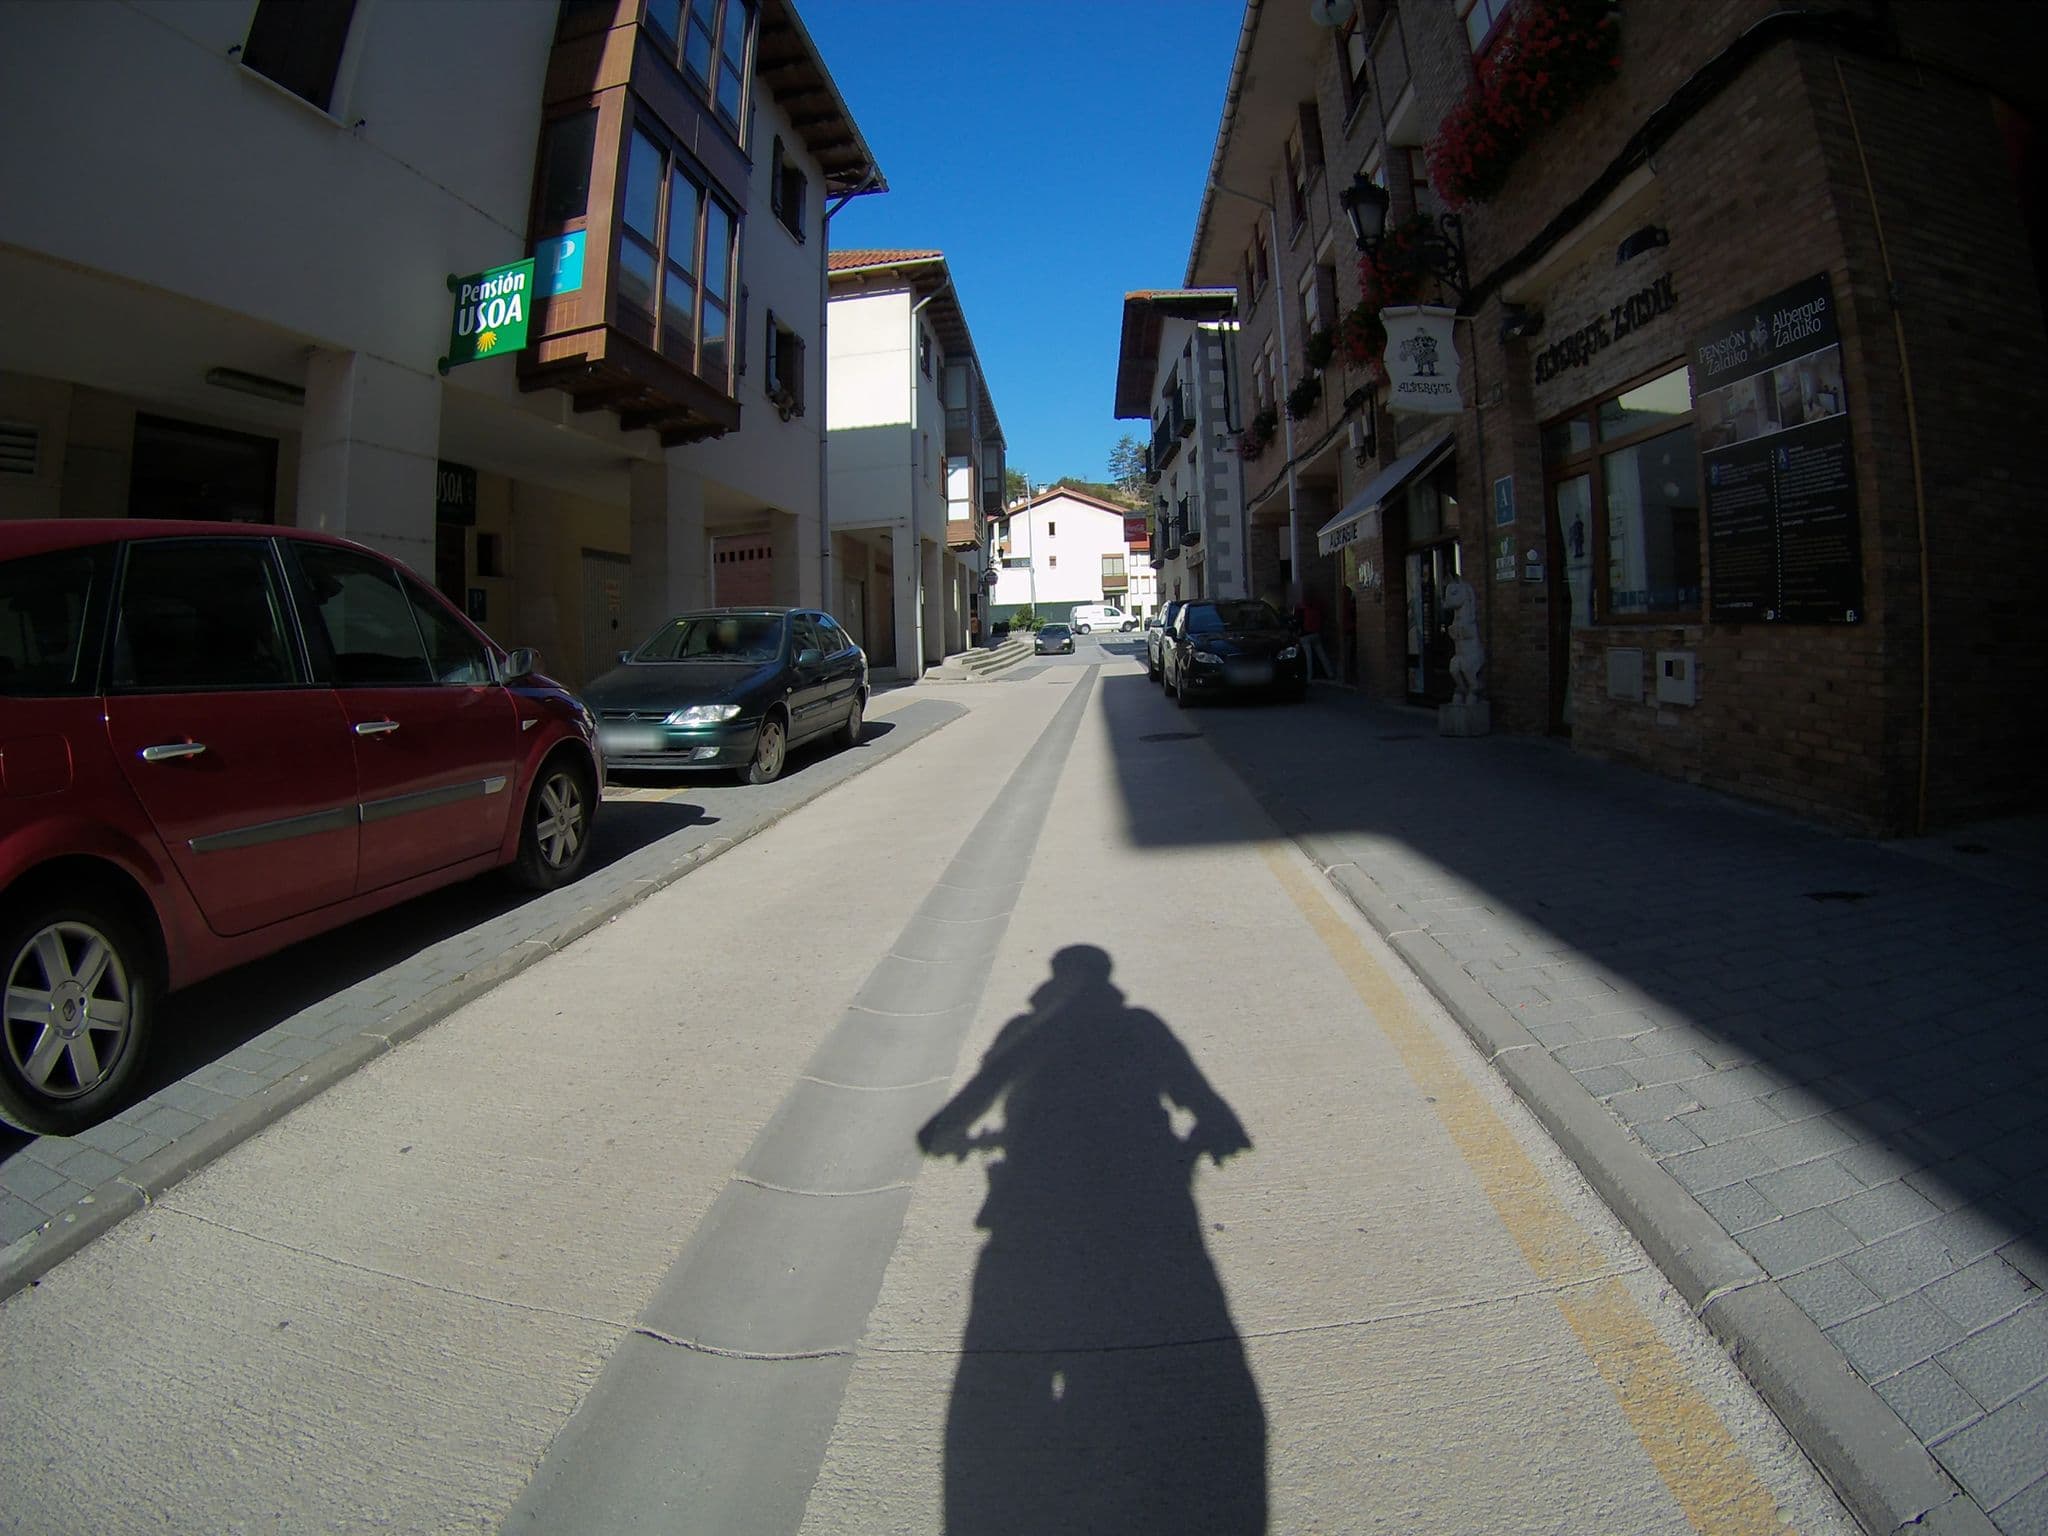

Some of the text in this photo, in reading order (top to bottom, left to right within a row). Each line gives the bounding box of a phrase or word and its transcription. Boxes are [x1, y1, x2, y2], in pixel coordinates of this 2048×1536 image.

[552, 239, 576, 274] P
[460, 271, 525, 305] Pensión
[457, 293, 523, 336] USOA
[1772, 296, 1826, 331] Albergue
[1697, 329, 1747, 364] PENSIÓN
[1774, 318, 1822, 348] Zaldiko
[1706, 349, 1748, 376] Zaldiko
[1397, 381, 1453, 395] ALBERGUE
